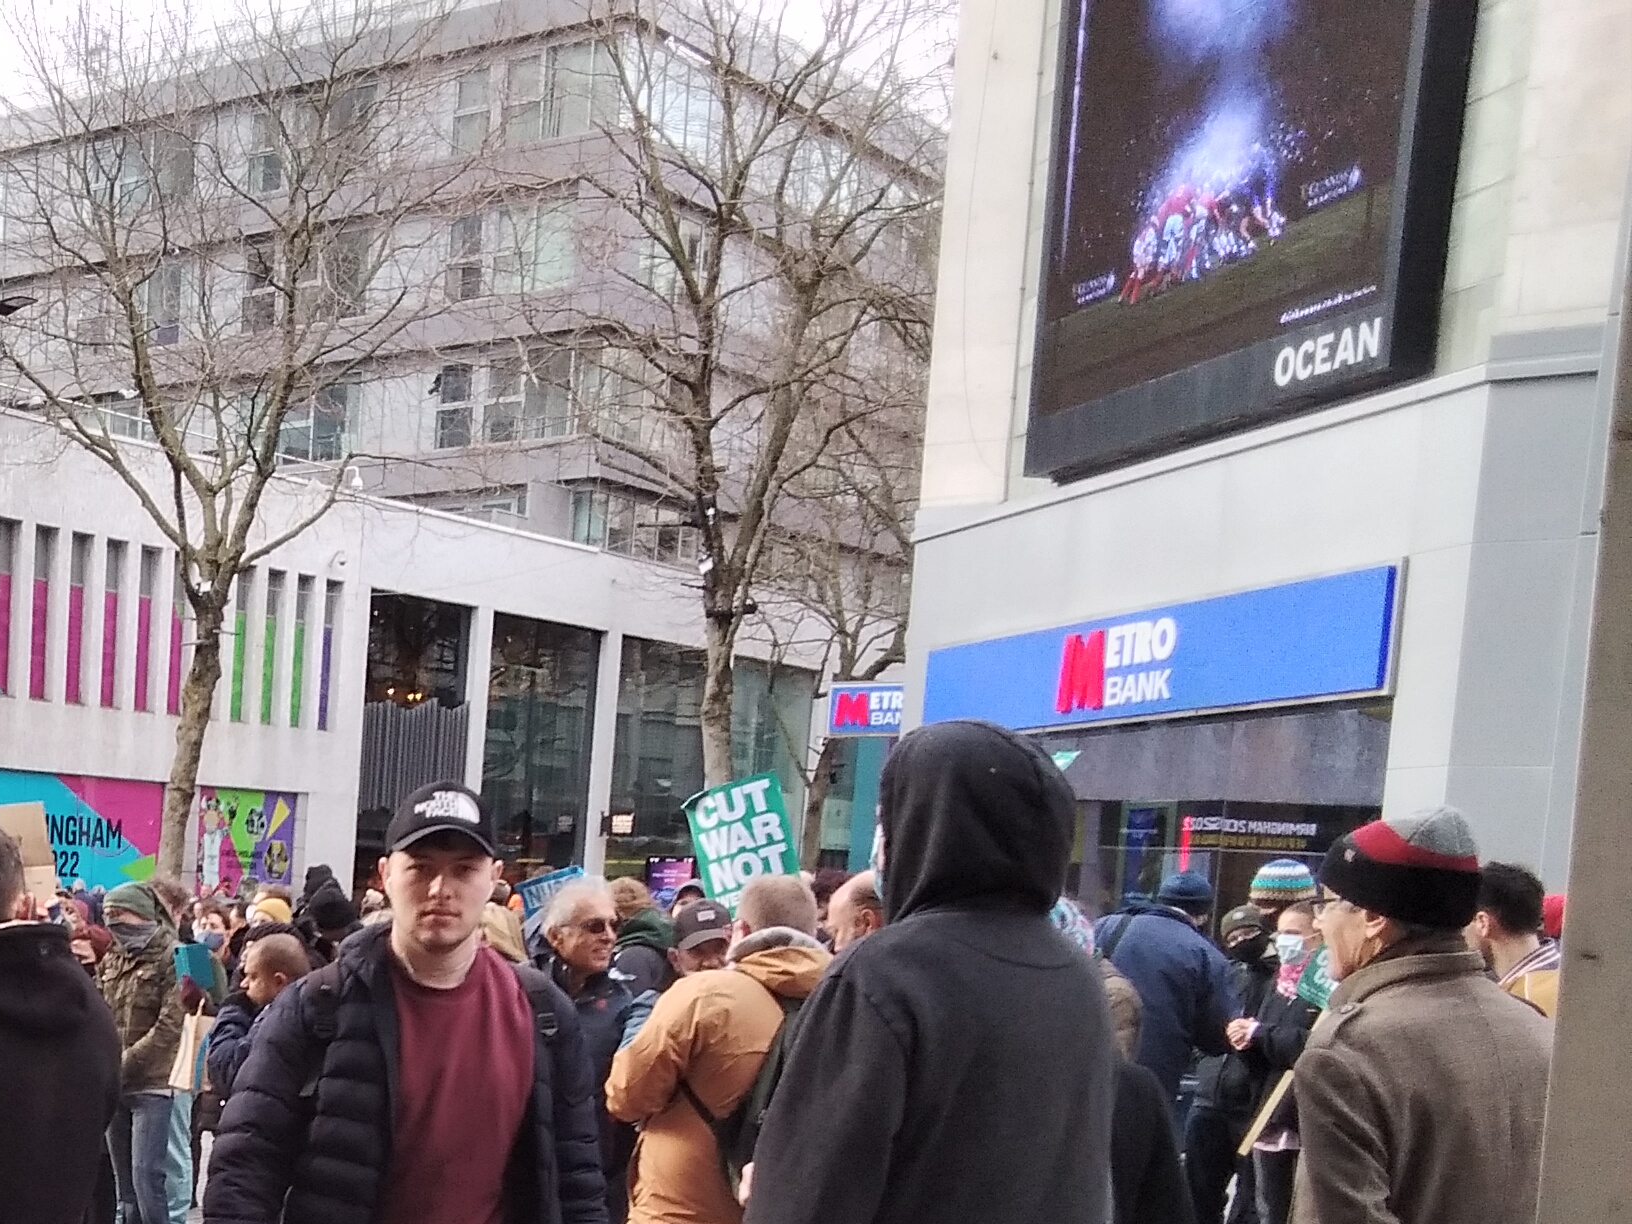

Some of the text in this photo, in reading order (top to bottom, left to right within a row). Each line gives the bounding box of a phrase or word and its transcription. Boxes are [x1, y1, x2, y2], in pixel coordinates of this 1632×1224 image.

[1274, 317, 1381, 386] OCEAN
[1055, 617, 1177, 714] METRO
[1104, 668, 1172, 706] BANK
[834, 691, 903, 726] METR
[414, 799, 459, 814] NORTH
[424, 808, 459, 818] FACE
[432, 791, 458, 802] THE
[695, 778, 771, 829] CUT
[698, 812, 785, 861] WAR
[708, 842, 788, 894] NOT
